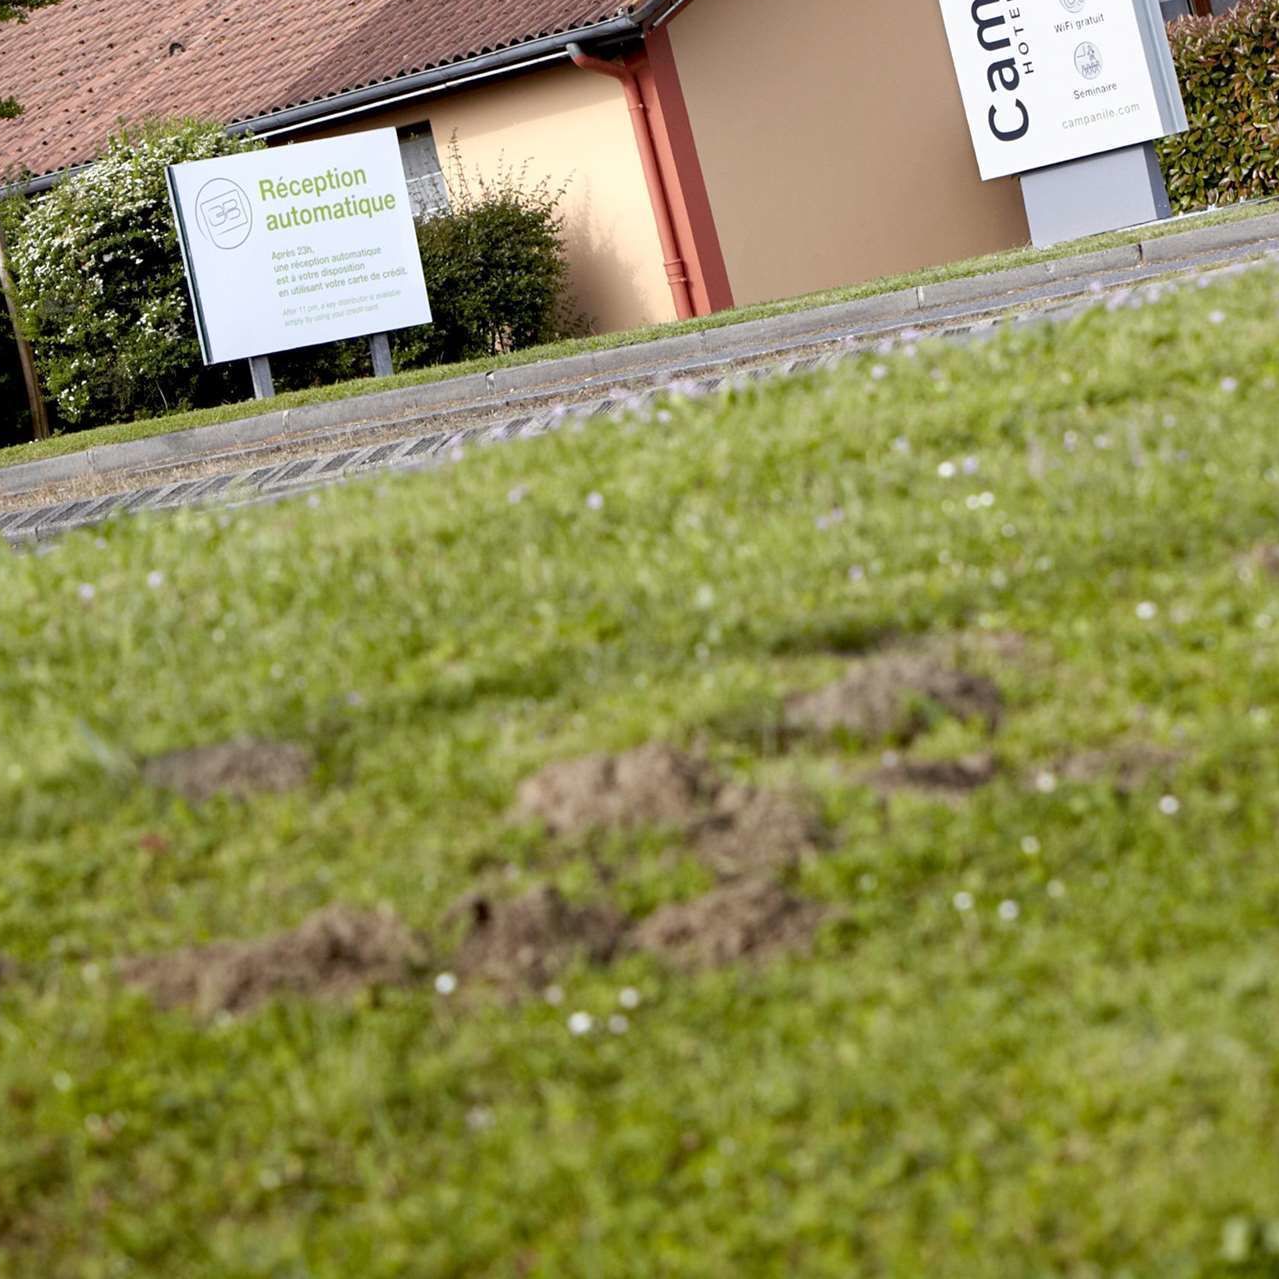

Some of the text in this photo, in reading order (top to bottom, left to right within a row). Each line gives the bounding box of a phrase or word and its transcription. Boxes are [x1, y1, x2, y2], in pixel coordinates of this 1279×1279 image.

[1054, 13, 1105, 33] WiFi gratuit
[1062, 102, 1140, 129] campanile.com
[258, 168, 367, 200] Réception
[266, 193, 396, 231] automatique
[274, 247, 381, 273] une réception automatique
[276, 276, 289, 285] est
[299, 271, 319, 281] votre
[321, 262, 365, 278] disposition
[278, 289, 289, 297] en
[325, 279, 346, 289] votre
[348, 275, 369, 285] carte
[370, 271, 380, 281] de
